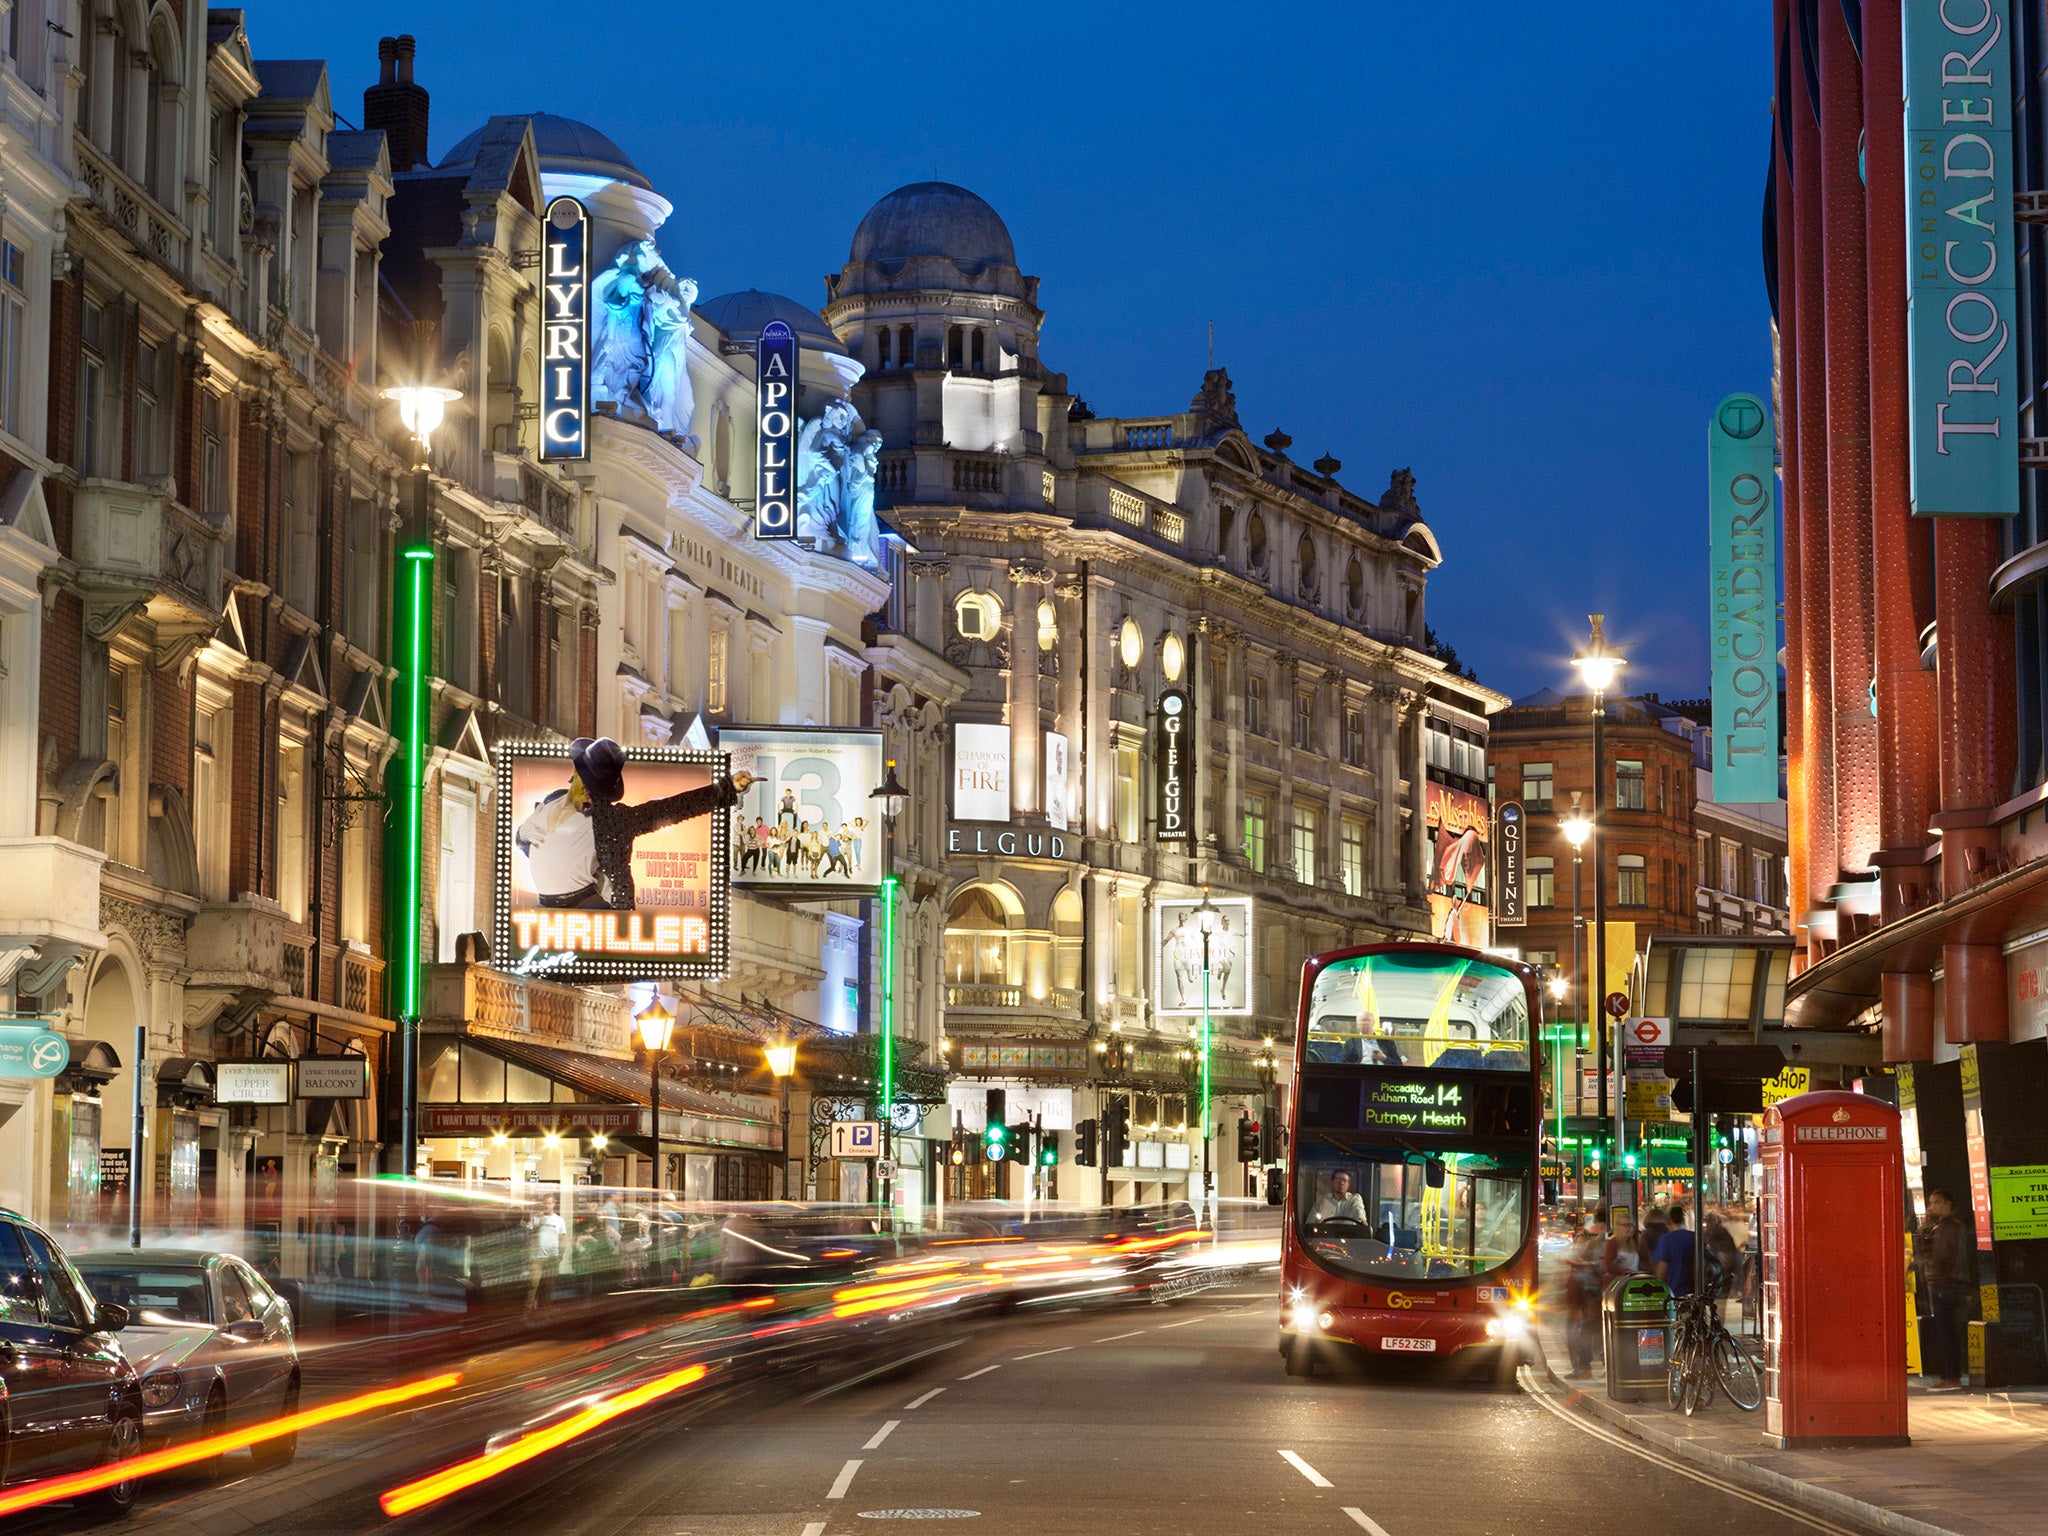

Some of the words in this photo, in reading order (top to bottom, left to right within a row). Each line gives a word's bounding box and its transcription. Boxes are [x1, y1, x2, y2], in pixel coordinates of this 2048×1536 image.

[1918, 138, 1939, 280] LONDON
[1936, 0, 2009, 456] TROCADERO
[546, 242, 581, 442] LYRIC
[760, 352, 791, 528] APOLLO
[671, 530, 713, 569] APOLLO
[719, 556, 765, 600] THEATRE
[1717, 568, 1729, 660] LONDON
[1726, 471, 1773, 768] TROCADERO
[957, 750, 1008, 762] CHARIOTS
[976, 760, 989, 769] OF
[958, 768, 1006, 793] FIRE
[1164, 716, 1181, 830] GIELGUD
[757, 756, 844, 835] 13
[948, 829, 1065, 859] ELGUD
[1158, 831, 1187, 839] THEATRE
[636, 850, 668, 860] FEATURING
[668, 852, 679, 861] THE
[679, 852, 700, 862] SONGS
[700, 853, 709, 862] OF
[645, 861, 698, 879] MICHAEL
[1504, 824, 1520, 916] QUEENS
[659, 879, 673, 888] AND
[673, 880, 685, 889] THE
[636, 887, 694, 907] JACKSON
[698, 890, 707, 908] 5
[512, 911, 708, 954] THRILLER
[513, 944, 578, 975] Live
[1612, 995, 1626, 1013] K
[232, 1089, 272, 1098] CIRCLE
[234, 1079, 269, 1088] UPPER
[305, 1079, 357, 1089] BALCONY
[1380, 1082, 1426, 1096] Piccadilly
[1371, 1092, 1407, 1104] Fulham
[1410, 1093, 1435, 1105] Road
[1438, 1083, 1462, 1107] 14
[442, 1114, 463, 1126] WANT
[464, 1114, 479, 1126] YOU
[481, 1114, 500, 1126] BACK
[513, 1114, 525, 1126] I'LL
[528, 1114, 537, 1126] BE
[539, 1114, 560, 1126] THERE
[572, 1114, 587, 1126] CAN
[589, 1114, 604, 1126] YOU
[605, 1114, 621, 1126] FEEL
[622, 1114, 630, 1126] IT
[1365, 1108, 1417, 1129] Putney
[1422, 1110, 1467, 1127] Heath
[1801, 1127, 1883, 1139] TELEPHONE
[1385, 1338, 1411, 1349] LF52
[1413, 1339, 1432, 1350] ZSR
